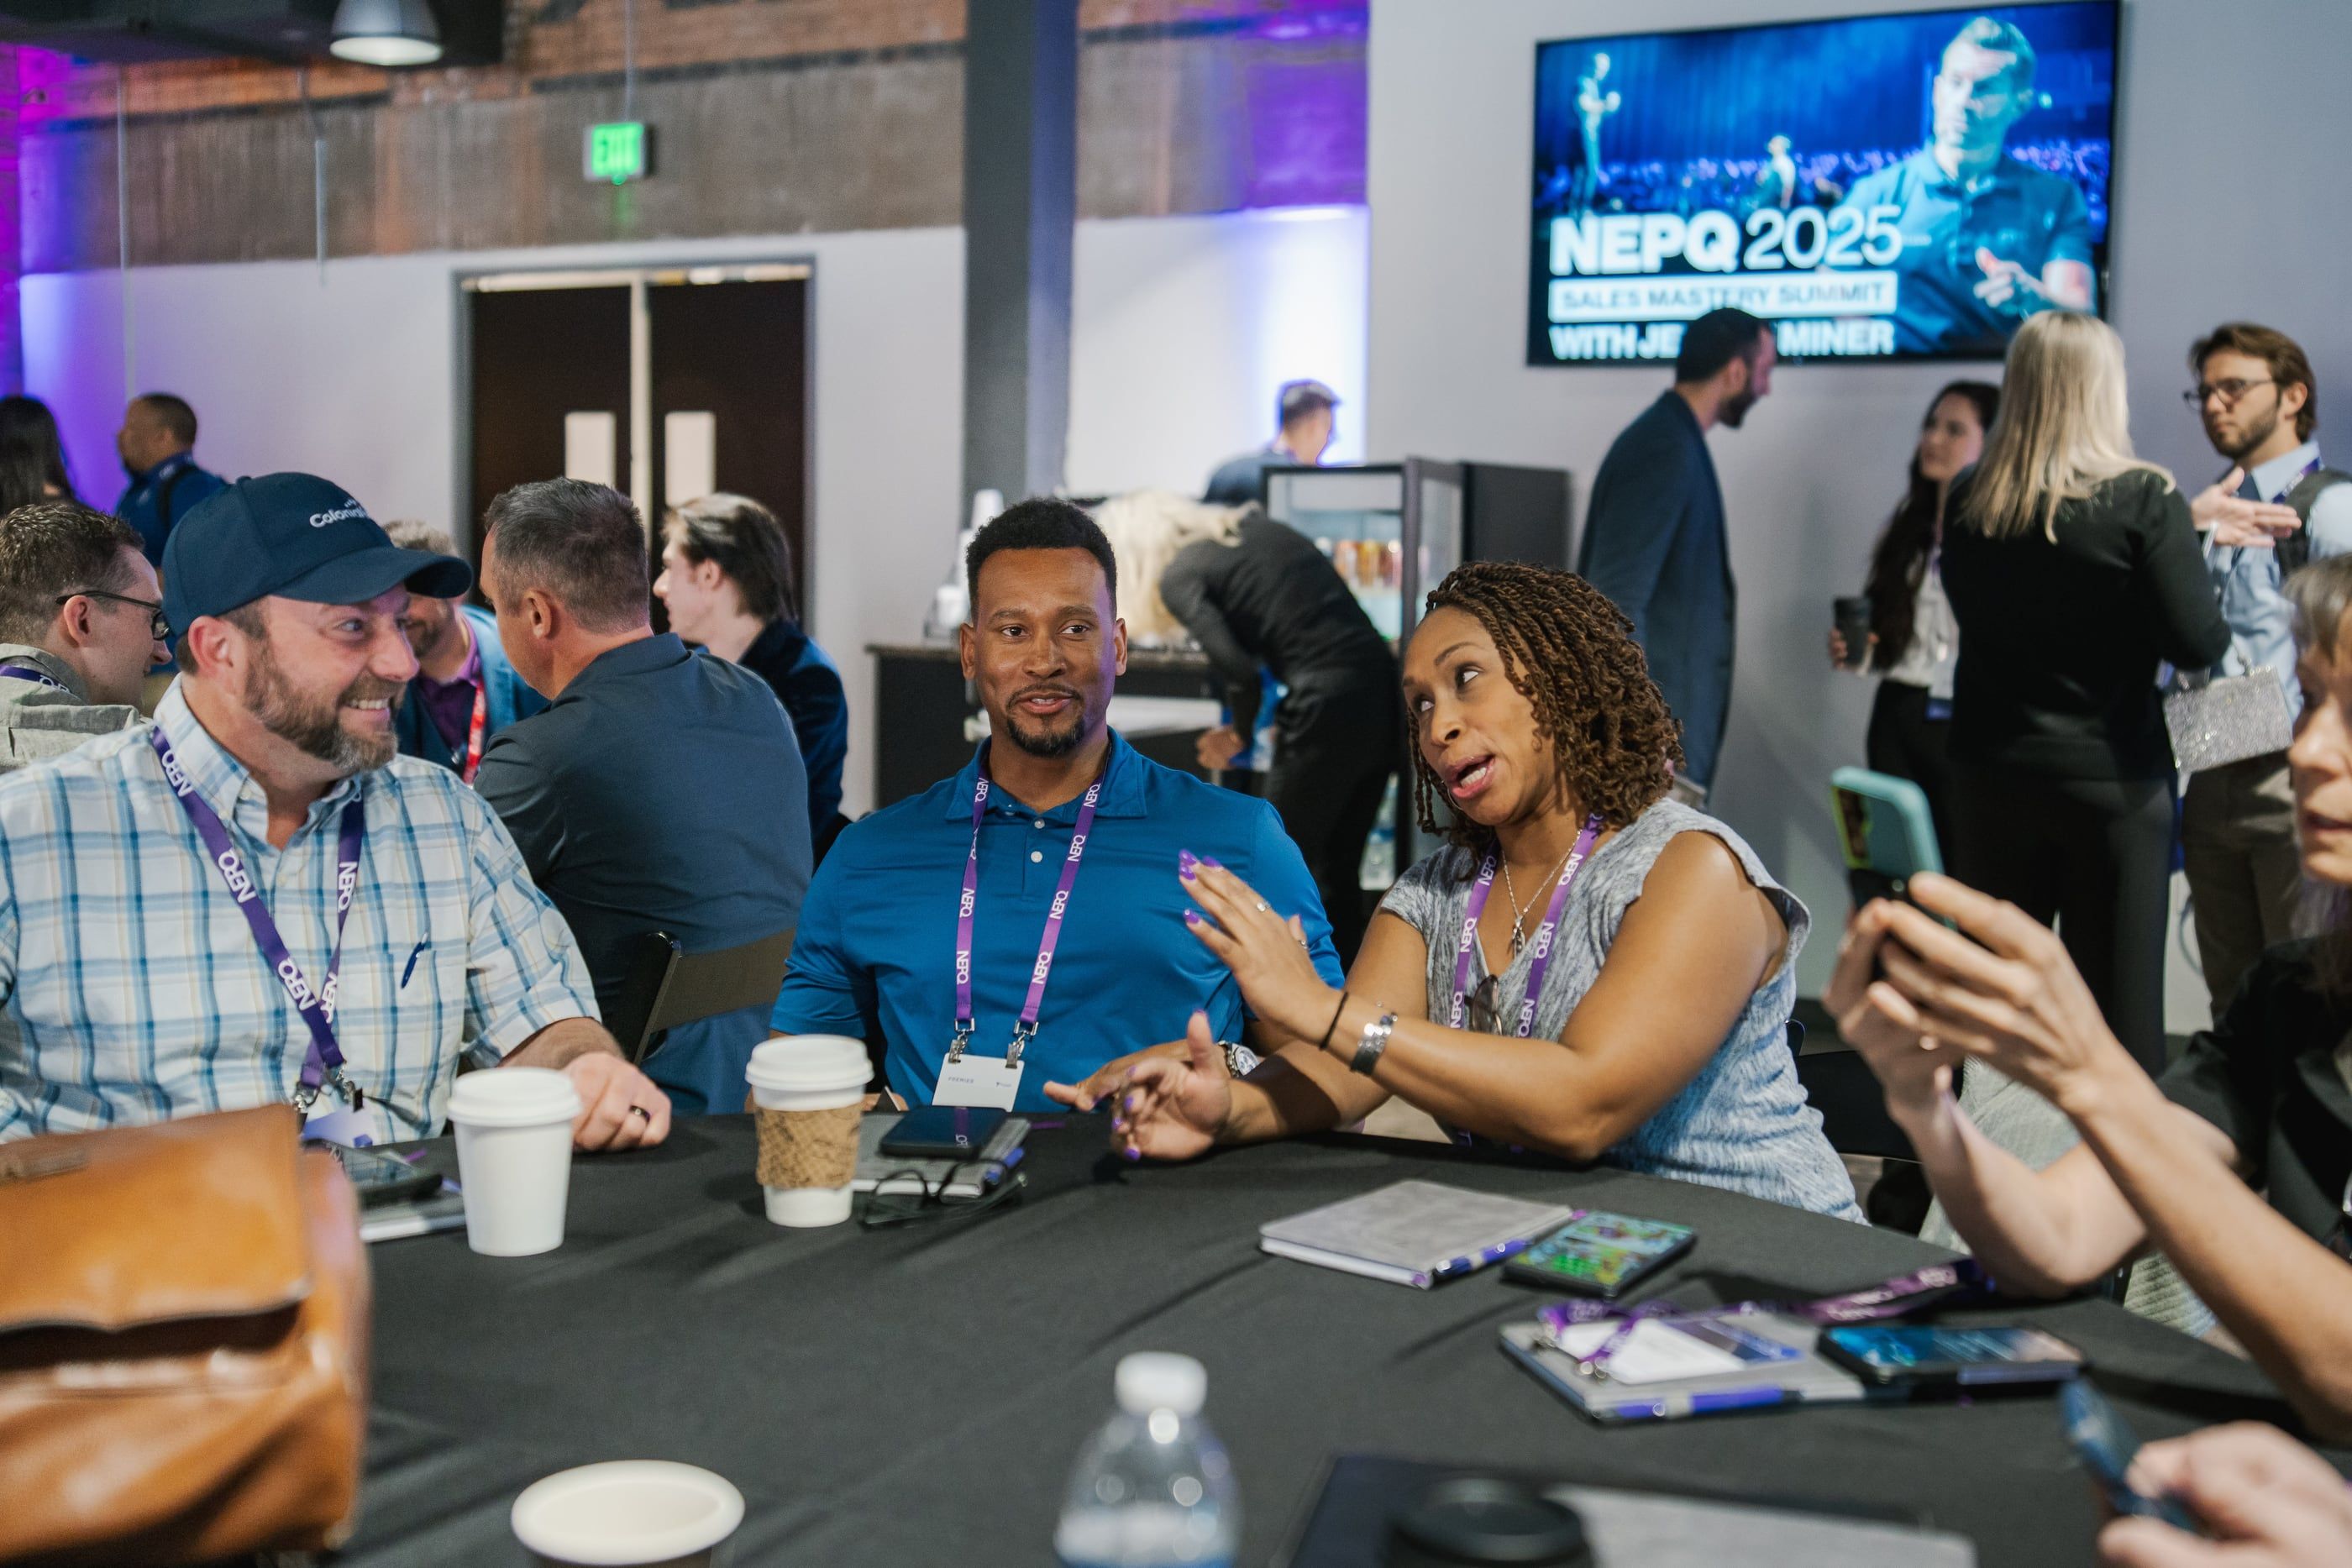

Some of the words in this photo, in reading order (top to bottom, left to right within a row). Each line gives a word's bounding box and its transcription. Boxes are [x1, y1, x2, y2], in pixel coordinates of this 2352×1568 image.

[1549, 210, 1740, 275] NEPQ
[1744, 205, 1903, 270] 2025
[1562, 285, 1641, 310] SALES
[1649, 283, 1771, 309] MASTERY
[1778, 281, 1884, 304] SUMMIT
[1548, 323, 1637, 359] WITH
[1777, 319, 1894, 356] MINER
[161, 750, 194, 797] NEPQ
[974, 778, 989, 803] NEPQ
[1084, 783, 1100, 808] NEPQ
[1068, 834, 1086, 863] NEPQ
[218, 847, 256, 903] NEPQ
[1478, 855, 1496, 886] NEPQ
[1558, 852, 1583, 886] NEPQ
[339, 862, 358, 913] NEPQ
[959, 888, 974, 918] NEPQ
[1049, 889, 1069, 920] NEPQ
[1460, 917, 1477, 952] NEPQ
[1536, 921, 1555, 959] NEPQ
[278, 957, 317, 1011] NEPQ
[956, 951, 969, 984] NEPQ
[1032, 951, 1052, 985] NEPQ
[1450, 991, 1463, 1029] NEPQ
[1518, 999, 1536, 1037] NEPQ
